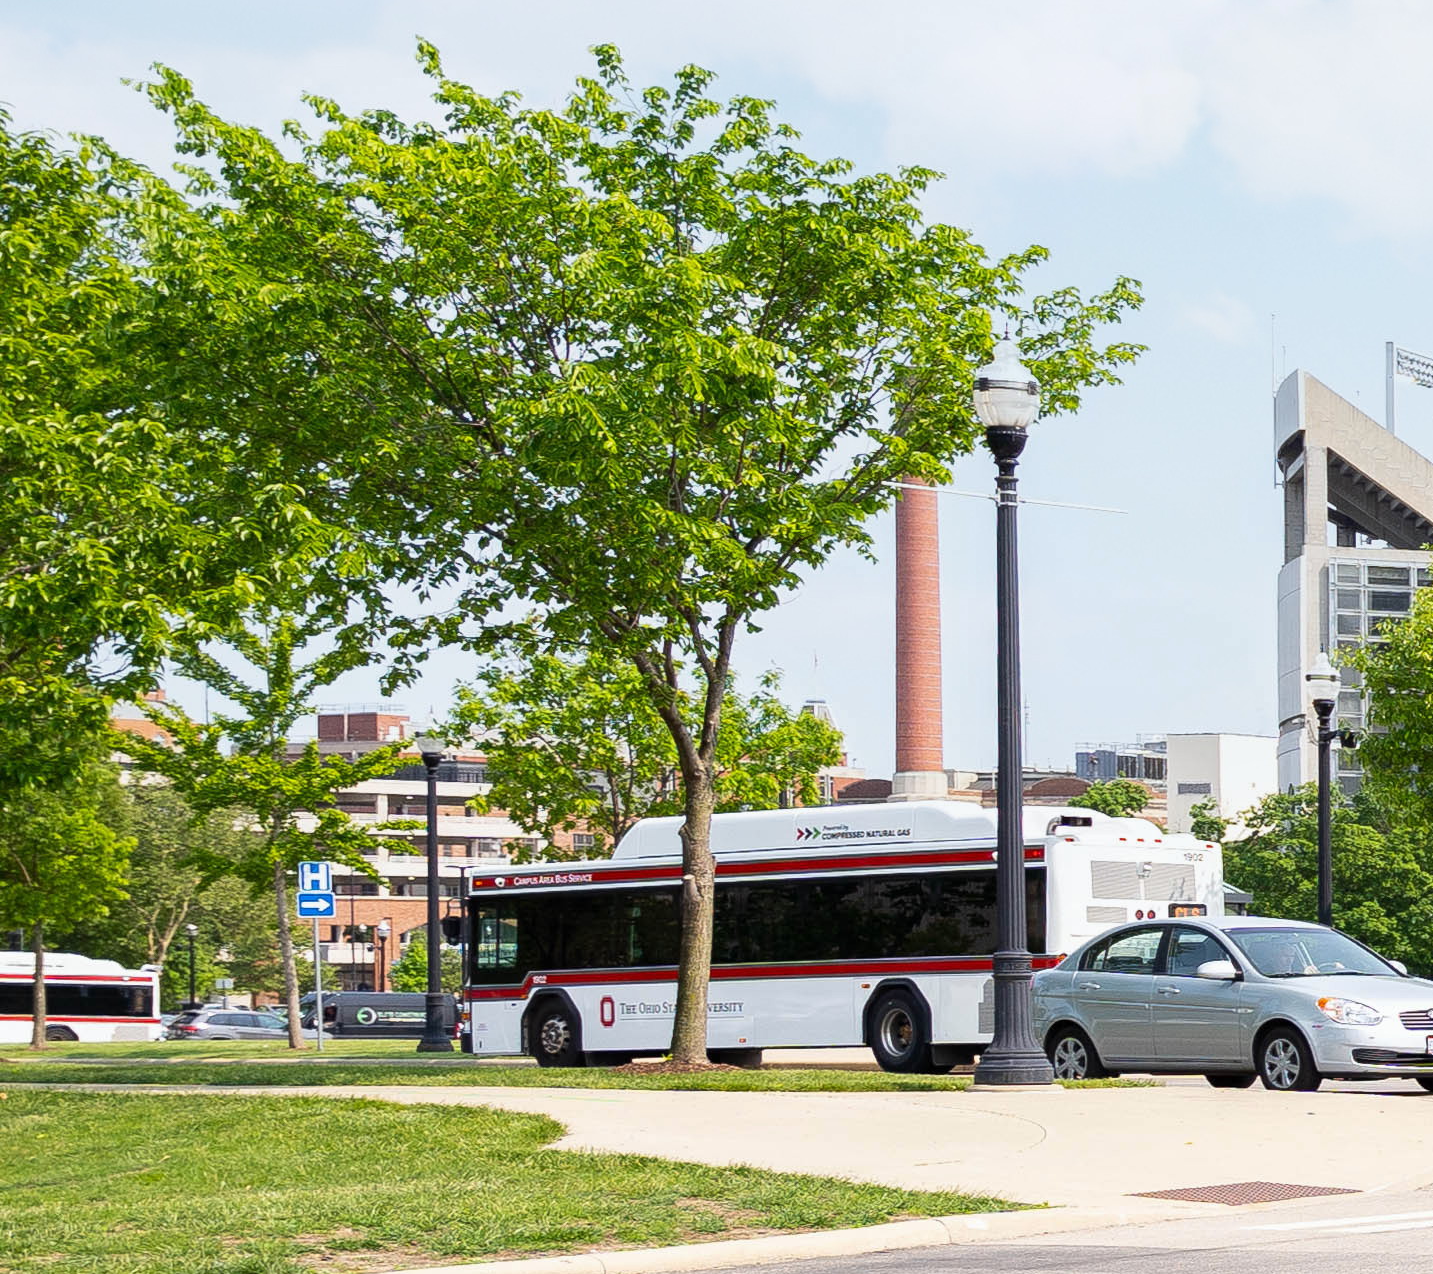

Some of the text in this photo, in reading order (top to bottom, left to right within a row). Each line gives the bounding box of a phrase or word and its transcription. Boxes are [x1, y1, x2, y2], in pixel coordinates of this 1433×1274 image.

[821, 828, 911, 840] COMPRESSED NATURAL GAS
[1183, 852, 1204, 862] 1902
[302, 862, 328, 891] H
[539, 875, 554, 885] AREA
[555, 874, 567, 884] BUS
[568, 873, 592, 883] SERVICE
[619, 1002, 637, 1015] THE
[638, 1001, 661, 1015] OHIO
[706, 1002, 744, 1013] VERSITY
